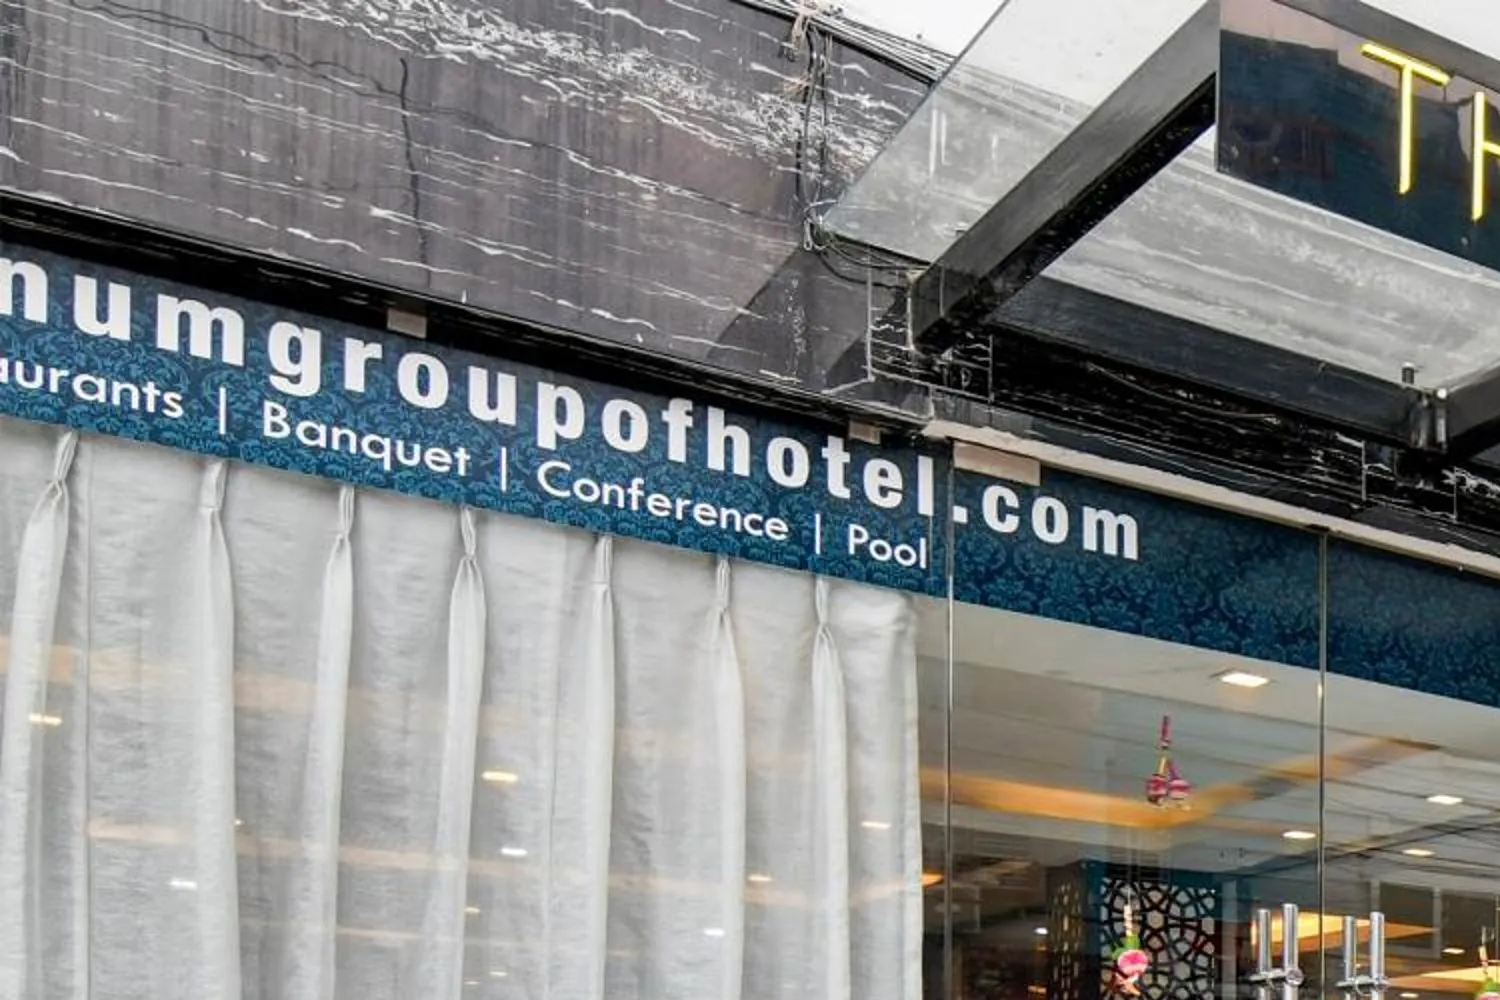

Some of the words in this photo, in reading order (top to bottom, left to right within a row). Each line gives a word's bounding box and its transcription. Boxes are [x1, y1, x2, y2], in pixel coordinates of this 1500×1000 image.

[262, 401, 471, 477] Banquet
[537, 460, 790, 542] Conference
[847, 524, 928, 570] Pool
